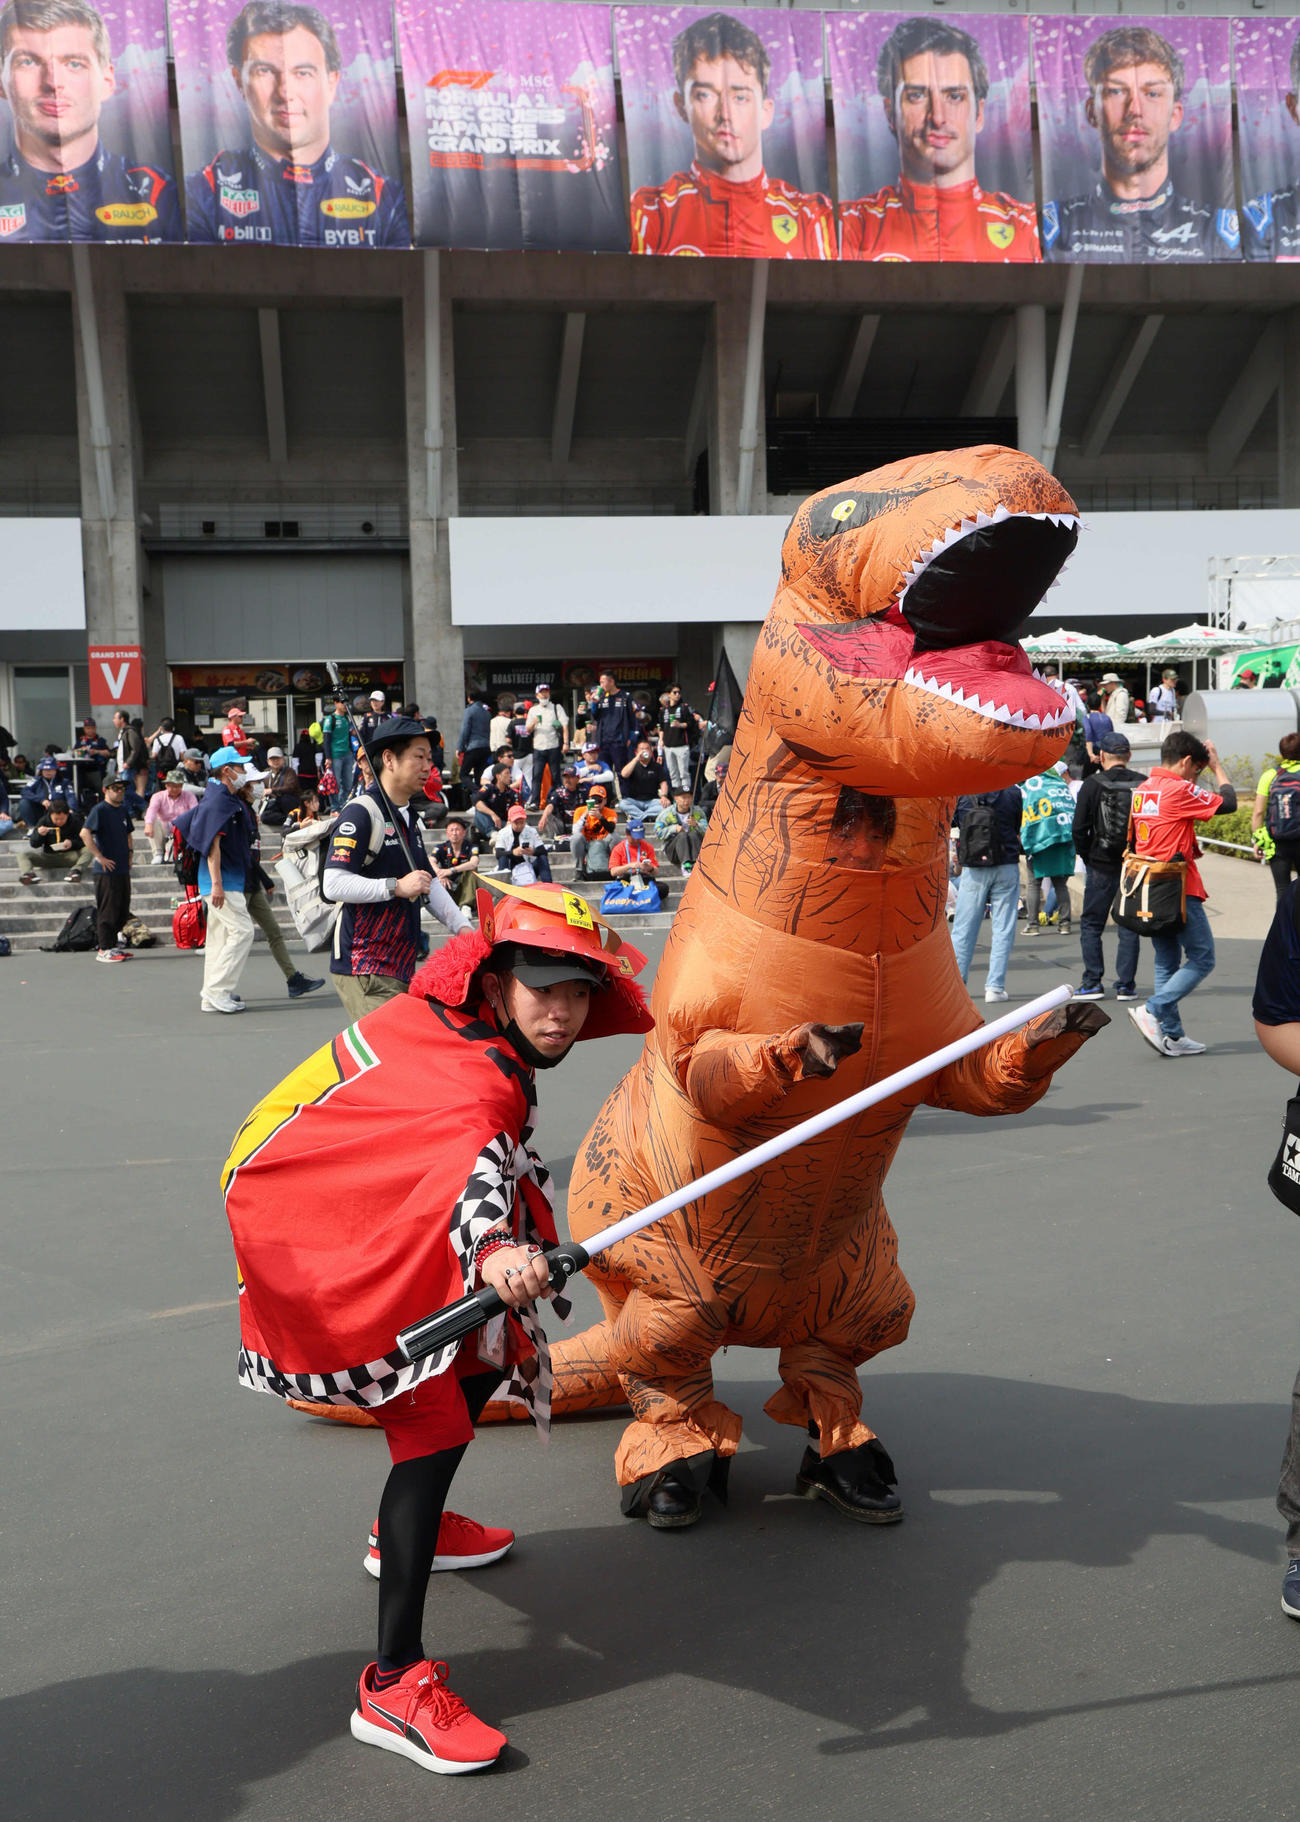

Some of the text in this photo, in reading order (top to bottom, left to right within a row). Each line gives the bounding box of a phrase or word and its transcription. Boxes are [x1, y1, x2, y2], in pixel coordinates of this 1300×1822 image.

[520, 75, 553, 87] MSC
[425, 87, 547, 108] FORMULA 1
[426, 104, 566, 124] MSC CRUISES
[428, 120, 538, 139] JAPANESE
[428, 135, 561, 155] GRAND PRIX
[430, 152, 485, 169] 2024
[223, 187, 257, 202] TAG
[112, 208, 151, 219] RAUCH
[325, 226, 376, 246] BYBIT
[100, 662, 131, 700] V
[491, 673, 533, 684] ROASTBEEF
[570, 918, 592, 928] Ferrari
[1282, 1162, 1300, 1186] TAM
